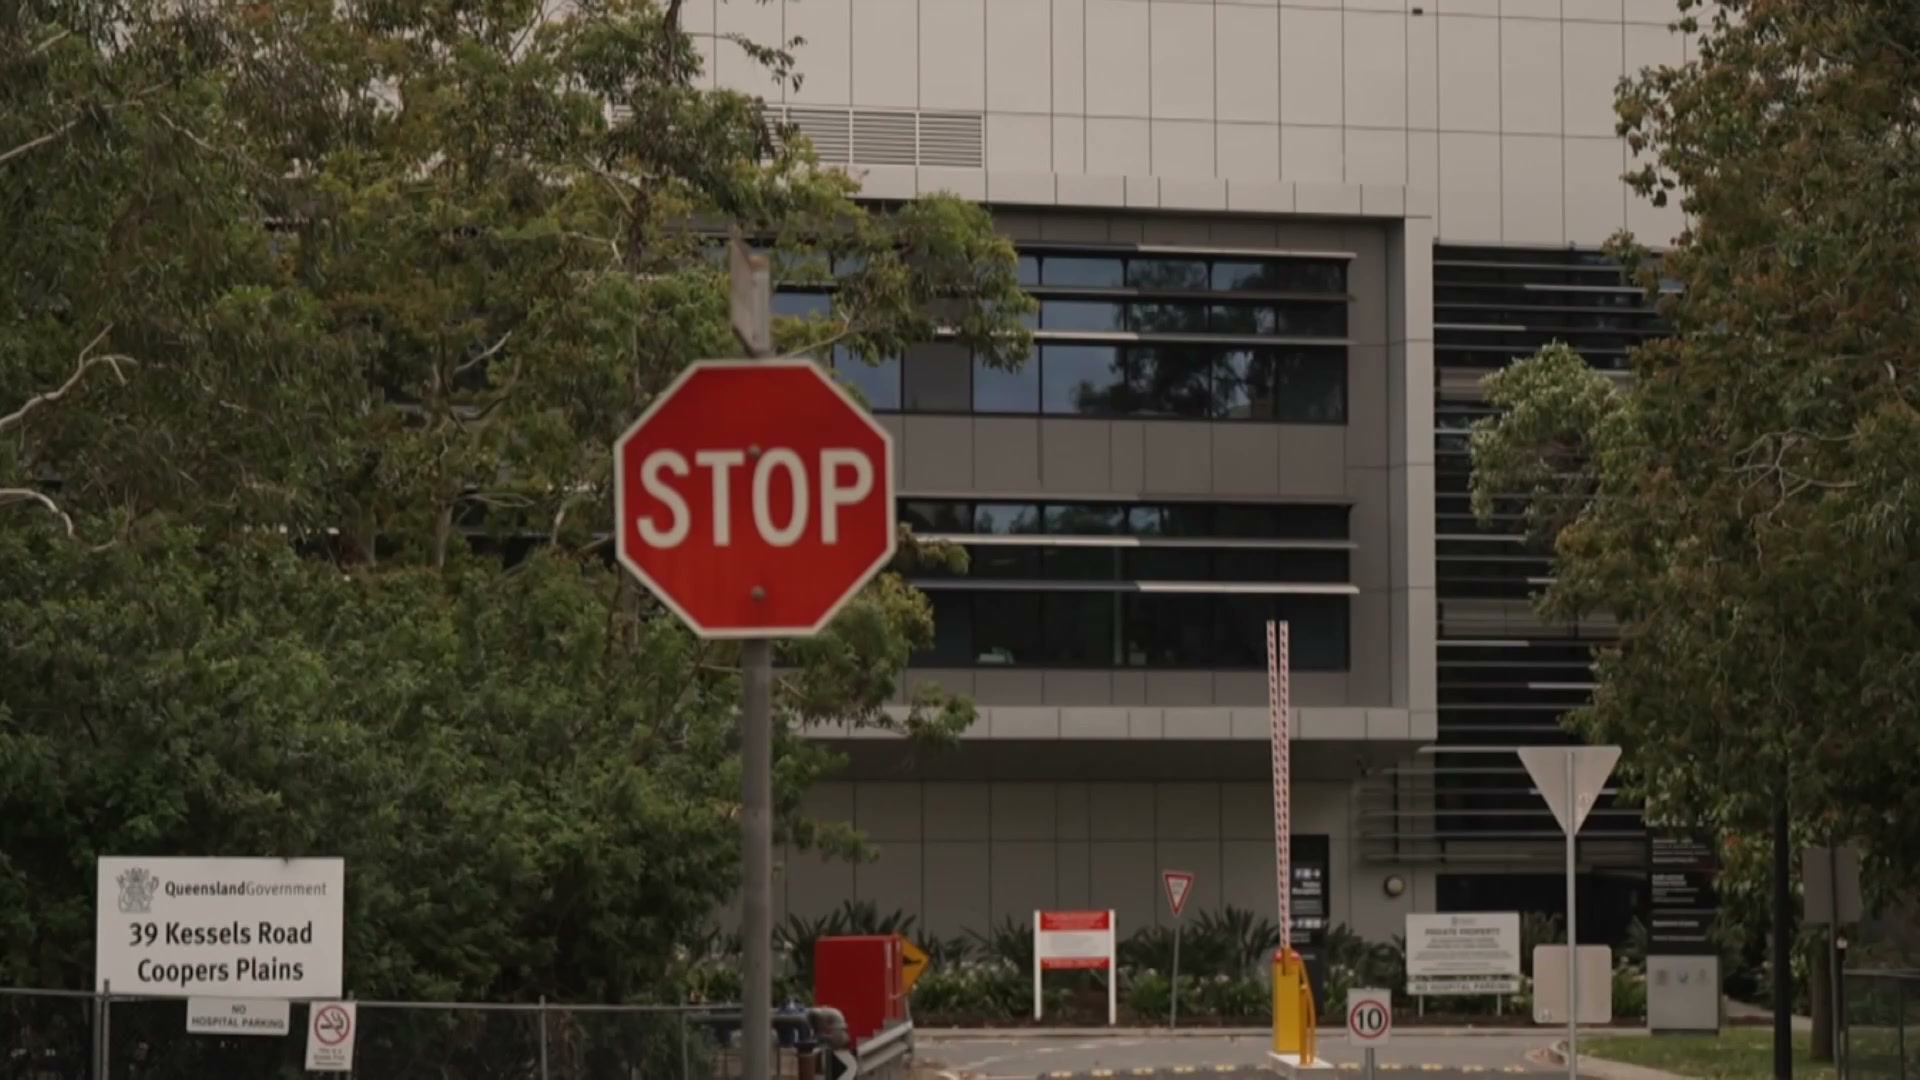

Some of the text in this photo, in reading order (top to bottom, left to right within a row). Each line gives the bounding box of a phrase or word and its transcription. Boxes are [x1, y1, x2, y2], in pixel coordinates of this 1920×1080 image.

[637, 447, 874, 548] STOP
[165, 880, 327, 898] QueenslandGovernment
[129, 921, 312, 946] 39 Kessels Road
[138, 957, 304, 987] Coopers Plains
[231, 1004, 247, 1014] NO
[1356, 1008, 1382, 1030] 10
[192, 1016, 285, 1029] HOSPITAL PARKING
